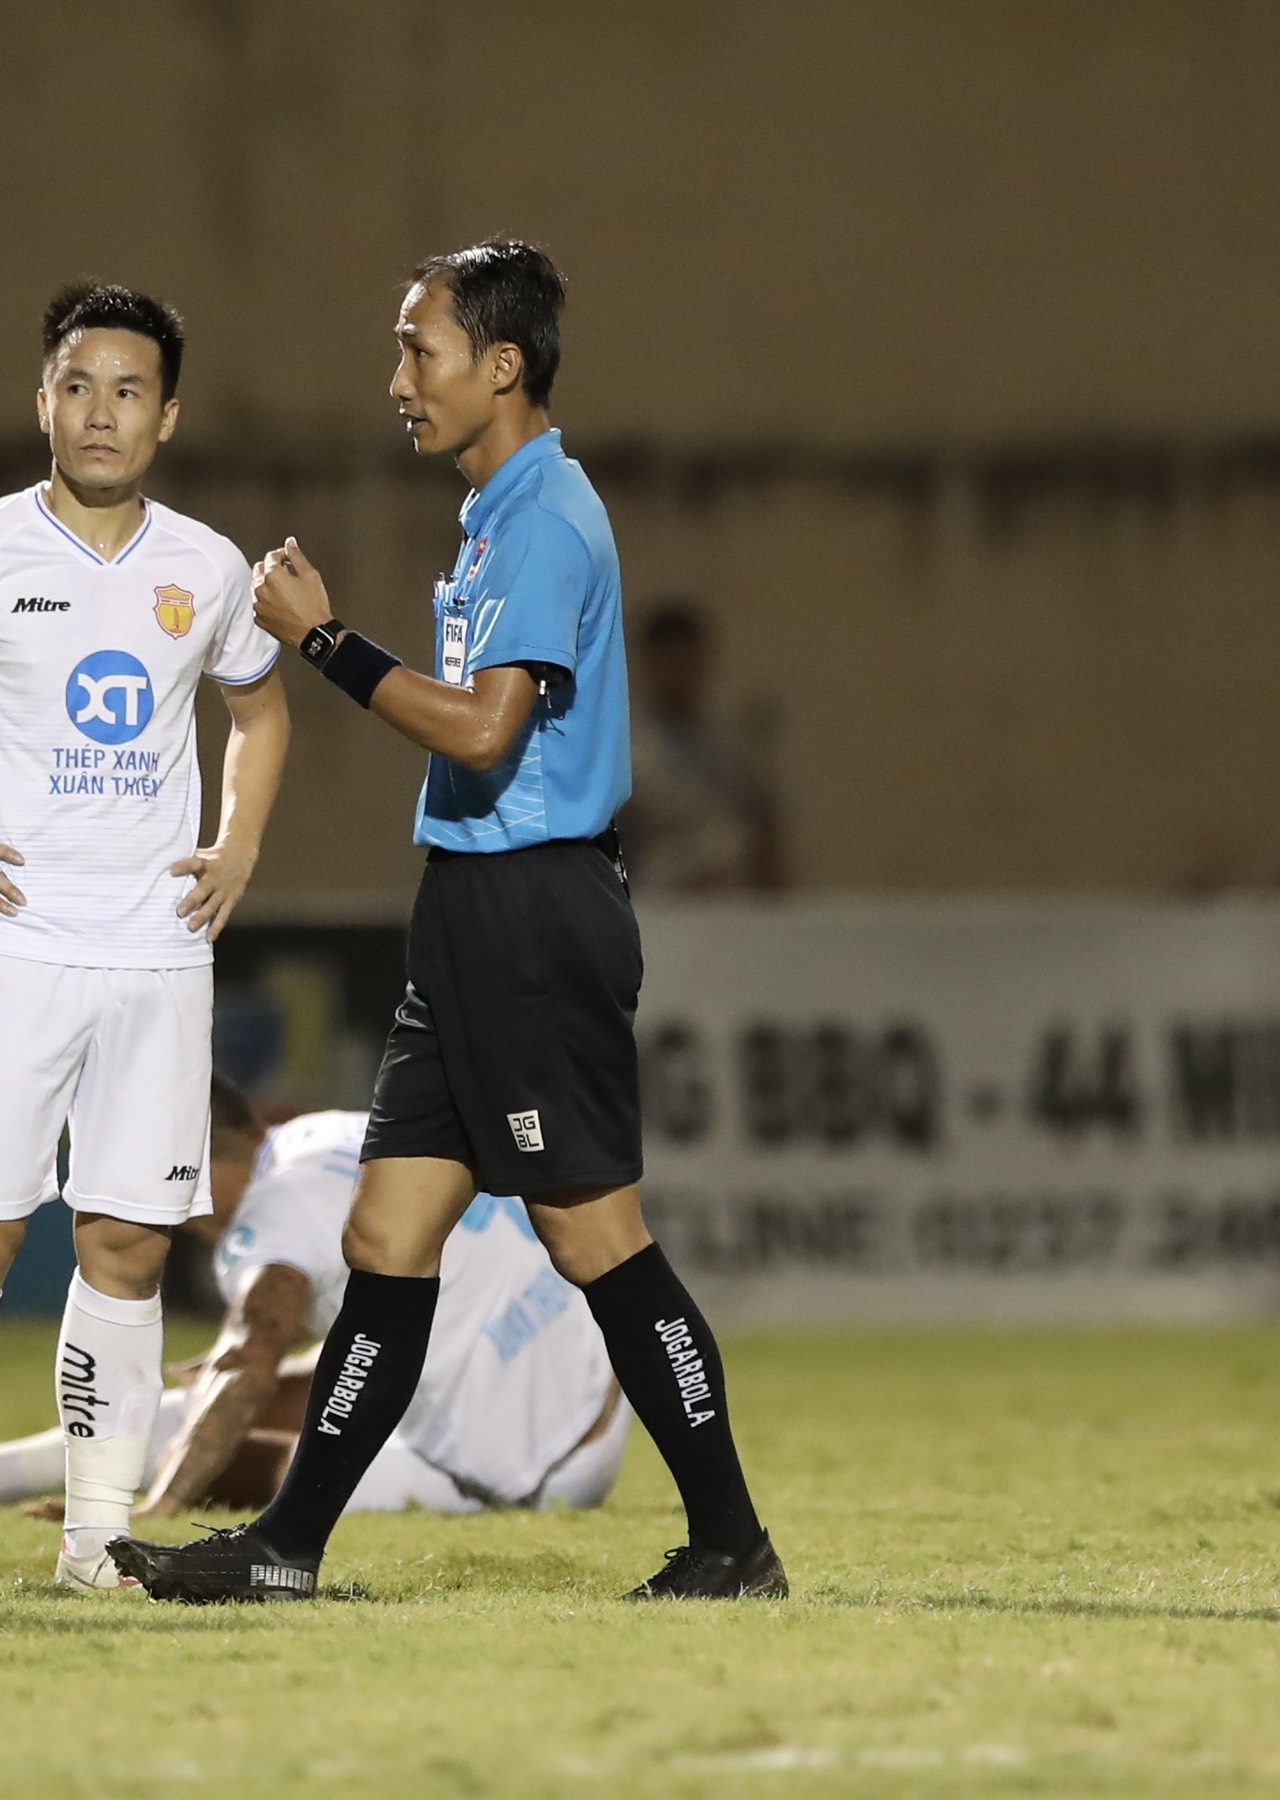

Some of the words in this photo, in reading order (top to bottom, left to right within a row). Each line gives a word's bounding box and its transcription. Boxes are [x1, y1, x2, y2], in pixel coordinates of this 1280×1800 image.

[10, 597, 71, 613] Mitre
[446, 623, 463, 644] FIFA
[76, 672, 149, 727] XT
[52, 744, 106, 769] THÉP
[112, 750, 160, 772] XANH
[49, 771, 104, 795] XUÂN
[742, 1016, 944, 1156] BBQ
[61, 1342, 110, 1438] mitre
[317, 1333, 382, 1436] JOGARBOLA
[654, 1317, 716, 1428] JOGARBOLA
[250, 1564, 315, 1594] PUMA
